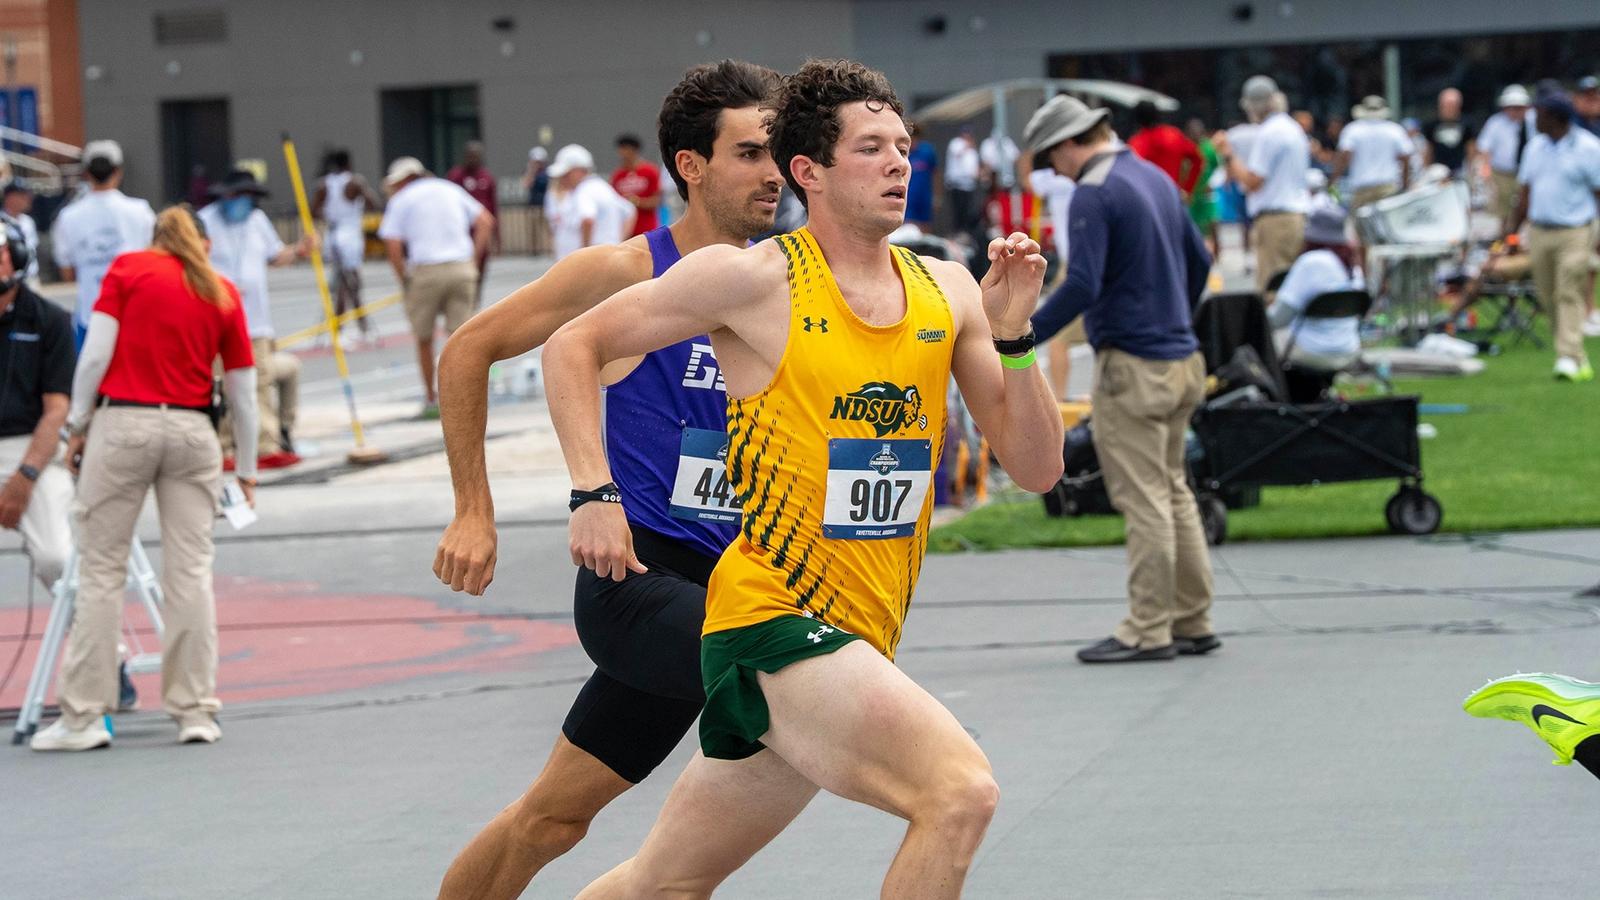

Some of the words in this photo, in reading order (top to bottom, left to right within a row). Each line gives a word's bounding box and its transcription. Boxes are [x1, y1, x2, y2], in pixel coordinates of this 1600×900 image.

[917, 330, 946, 340] SUMMIT
[682, 343, 726, 391] G
[829, 396, 901, 423] NDSU
[849, 478, 913, 522] 907
